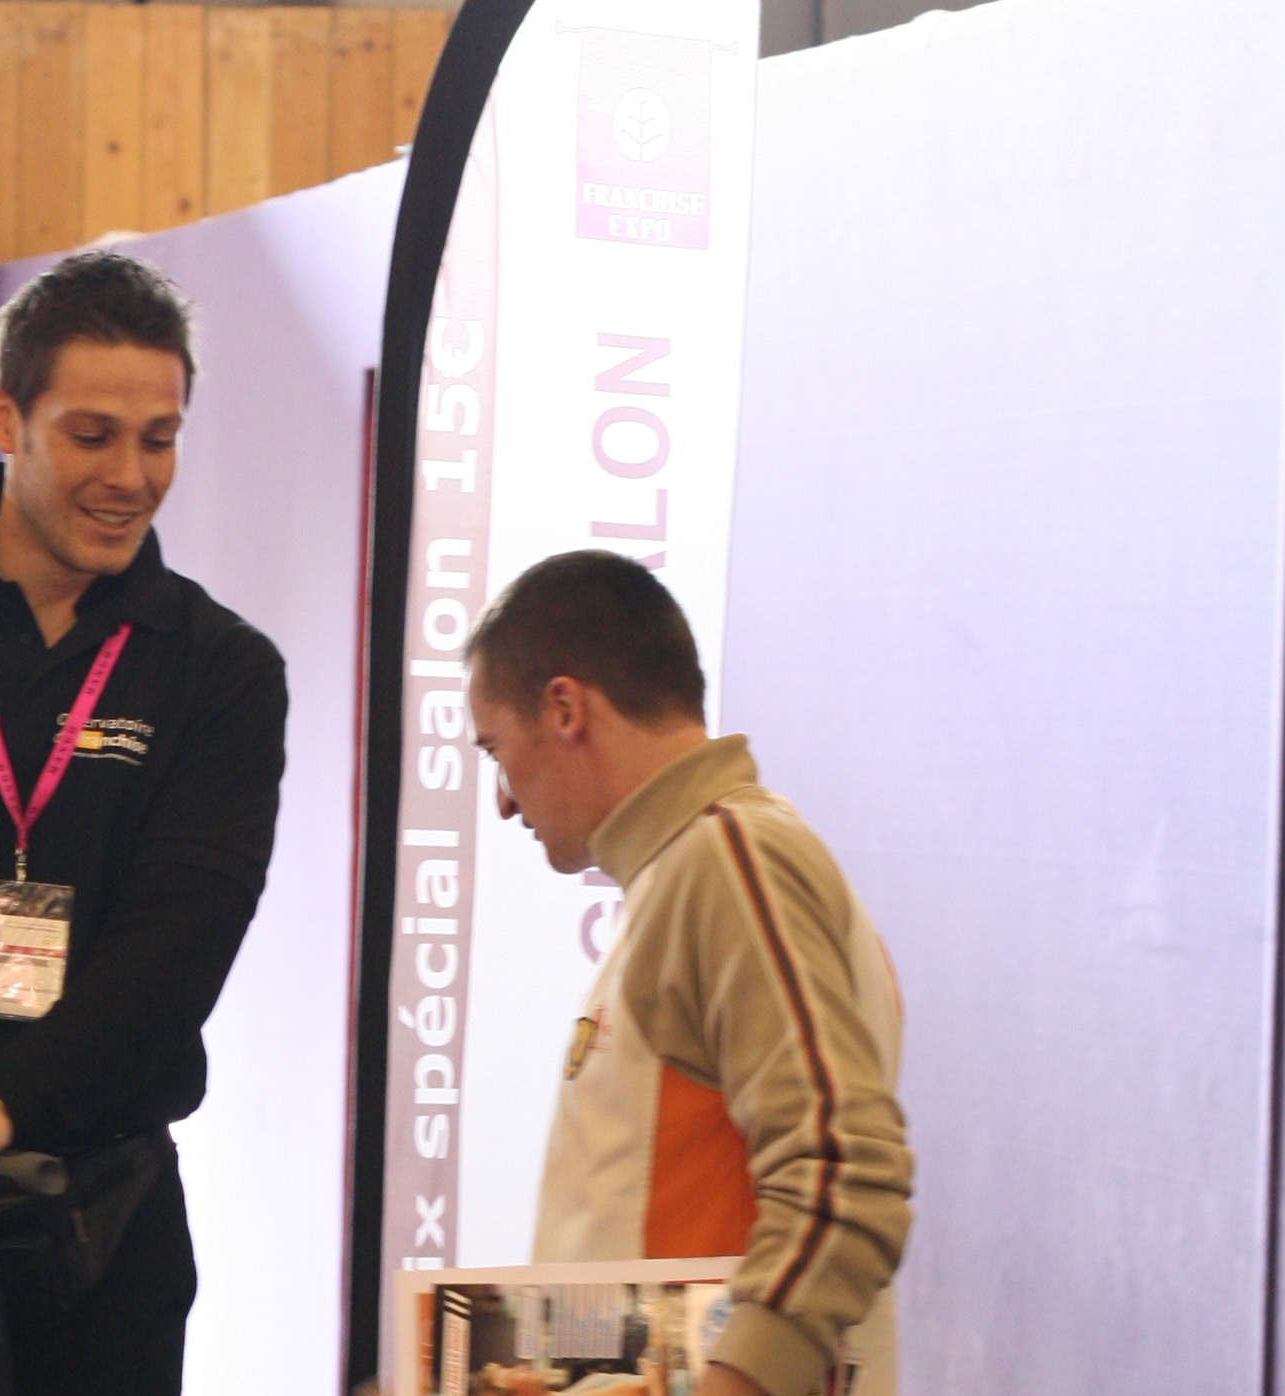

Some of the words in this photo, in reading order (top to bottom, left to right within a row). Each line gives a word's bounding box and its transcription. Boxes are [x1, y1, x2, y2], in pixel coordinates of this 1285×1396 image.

[583, 183, 705, 216] FRANCHISE
[610, 215, 672, 242] EXPO
[590, 332, 672, 575] LON
[410, 536, 473, 792] salon
[398, 828, 461, 1159] spécial
[401, 1192, 447, 1271] ix
